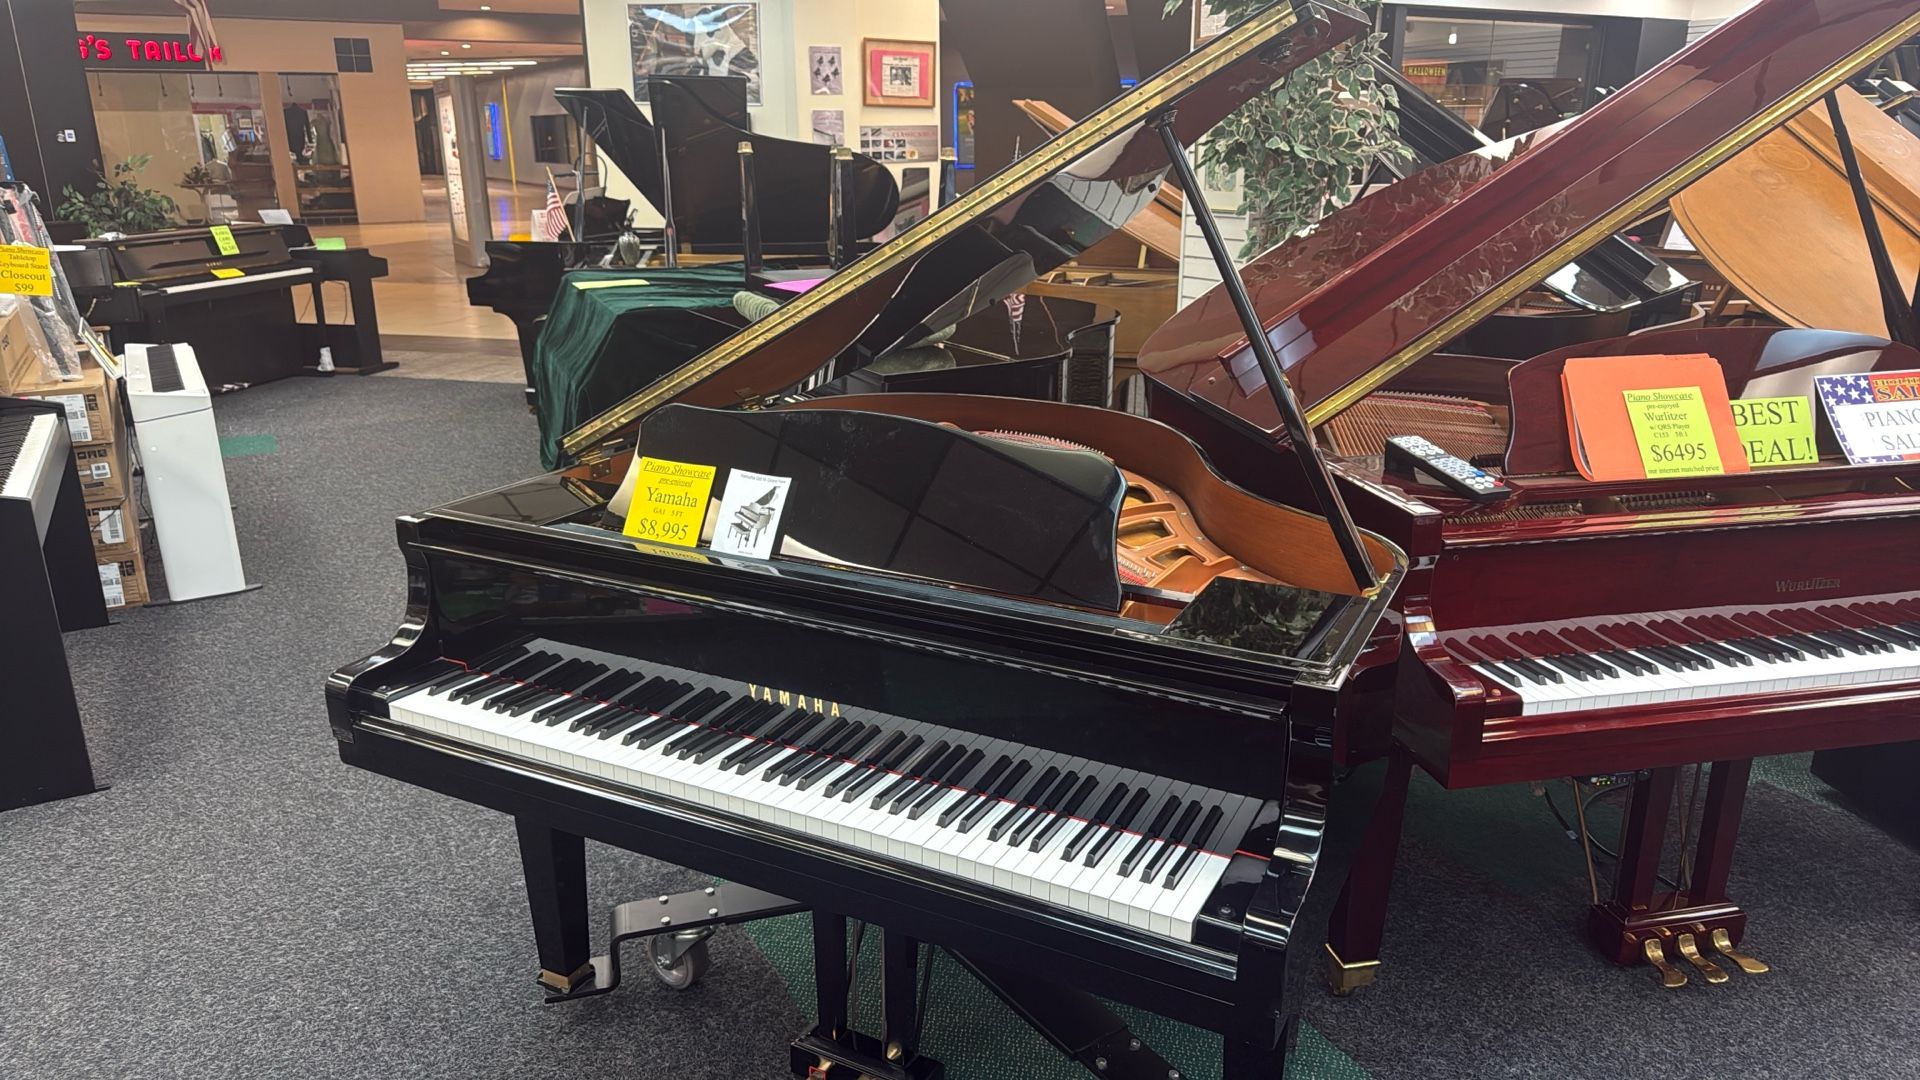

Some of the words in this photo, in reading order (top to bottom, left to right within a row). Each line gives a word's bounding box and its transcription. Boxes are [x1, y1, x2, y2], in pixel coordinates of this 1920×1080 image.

[8, 253, 37, 262] Tabletop
[1, 269, 46, 281] Closeout
[14, 283, 35, 292] $99
[1627, 392, 1651, 402] Piano
[1652, 391, 1694, 402] Showcase
[1646, 402, 1680, 411] pre-enjoyed
[1643, 411, 1688, 422] Wurlitzer
[1731, 400, 1799, 427] BEST
[1672, 423, 1690, 431] Player
[1881, 433, 1920, 451] SAL
[1650, 443, 1707, 463] $6495
[643, 460, 671, 473] Piano
[671, 464, 713, 479] Showcase
[1681, 465, 1705, 473] matched
[1706, 465, 1720, 473] price
[647, 486, 698, 508] Yamaha
[637, 517, 689, 541] $8,995
[748, 683, 840, 718] YAMAHA
